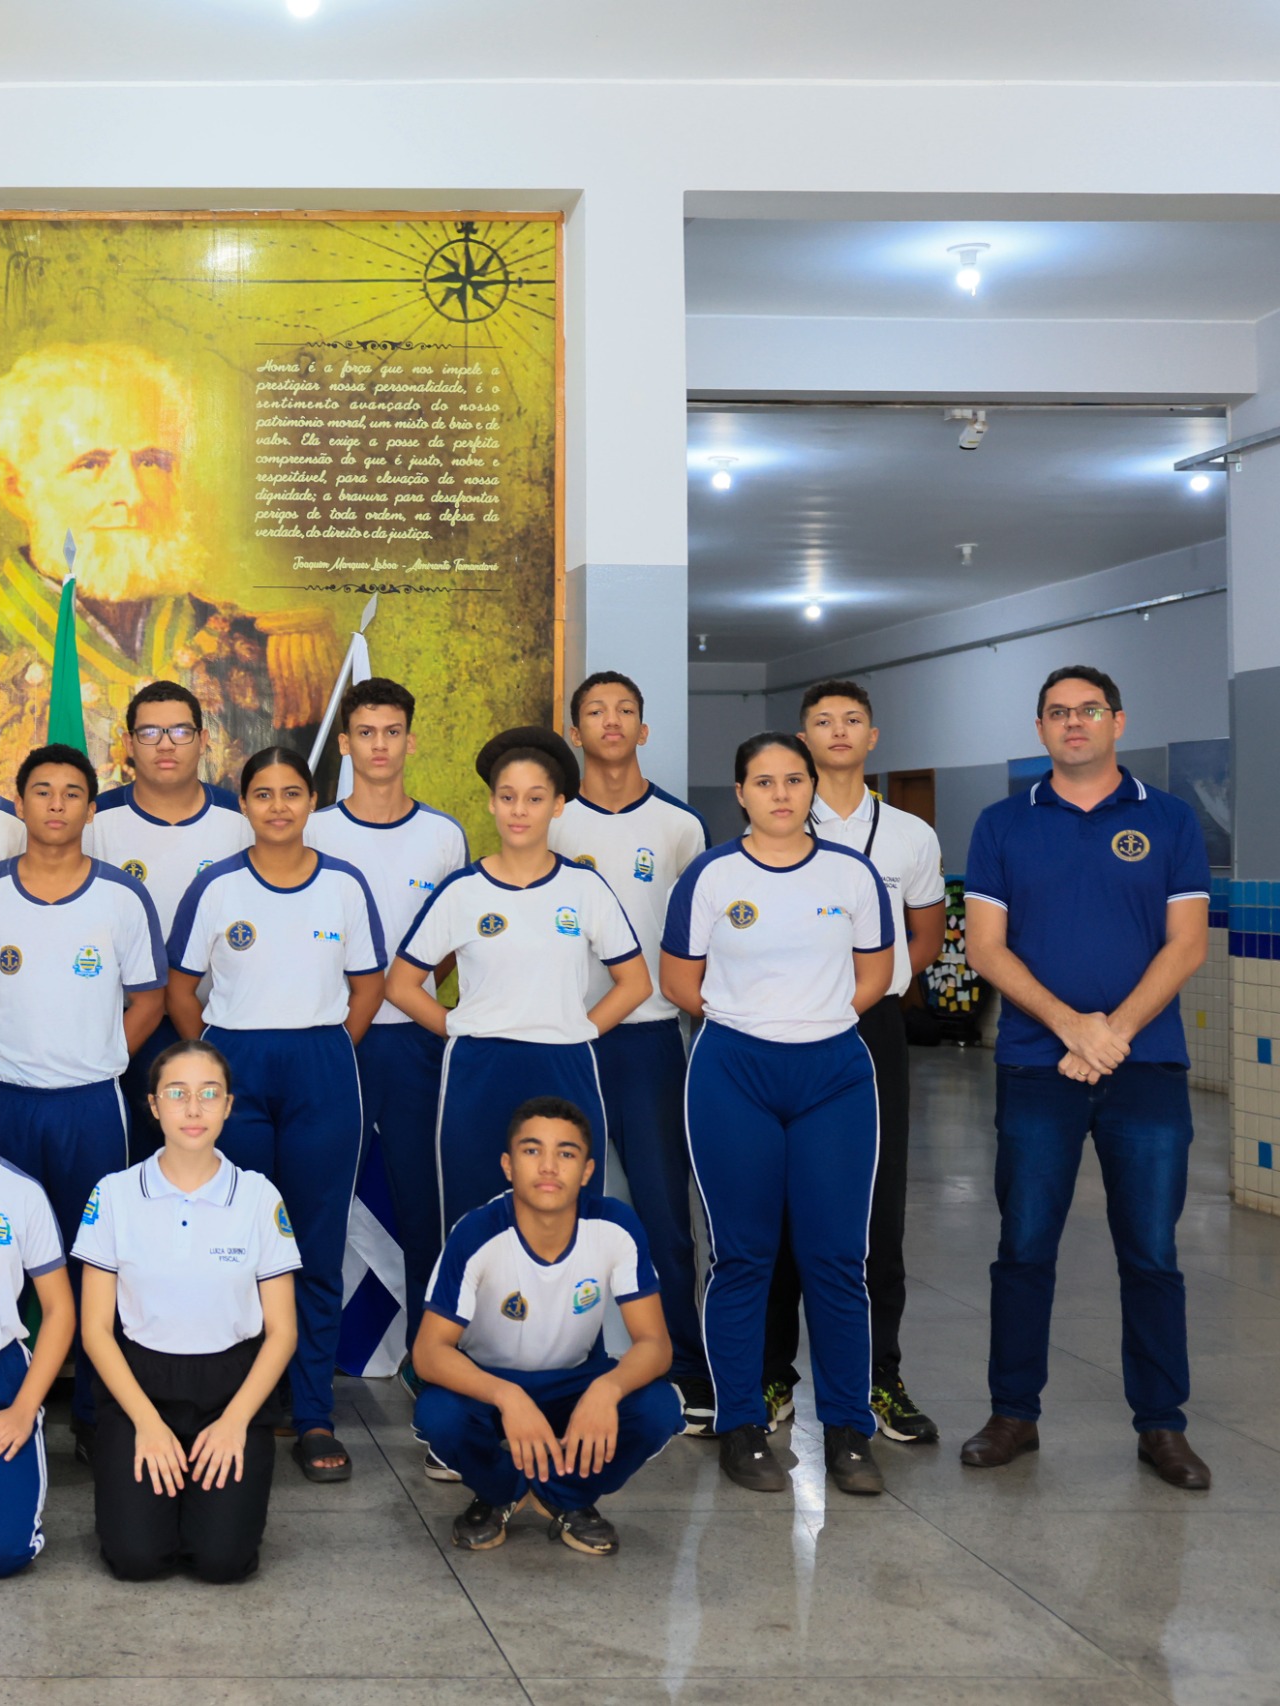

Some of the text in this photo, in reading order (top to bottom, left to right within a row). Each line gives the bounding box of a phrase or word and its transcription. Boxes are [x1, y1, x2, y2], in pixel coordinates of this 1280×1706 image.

[256, 359, 500, 379] Honra é a força que nos impele a
[255, 379, 501, 396] prestigiar nossa personalidade, é o
[256, 397, 500, 412] sentimento avançado do nosso
[255, 415, 500, 431] patrimônio moral, um misto de brio e de
[256, 432, 500, 453] valor. Ela exige a posse da perfeita
[256, 452, 334, 468] compreensão
[340, 452, 357, 465] do
[364, 457, 387, 470] que
[394, 454, 402, 465] é
[408, 454, 443, 471] justo,
[451, 454, 485, 466] nobre
[256, 469, 500, 487] respeitável, para elevação da nossa
[255, 488, 500, 508] dignidade; a bravura para desafrontar
[254, 506, 500, 527] perigos de toda ordem, na defesa da
[255, 524, 433, 544] verdade, do direito e da justiça.
[292, 556, 330, 570] Joaquim
[327, 557, 371, 572] Marques
[370, 557, 399, 571] Lisboa
[405, 558, 451, 573] Almirante
[409, 879, 435, 891] PALMA
